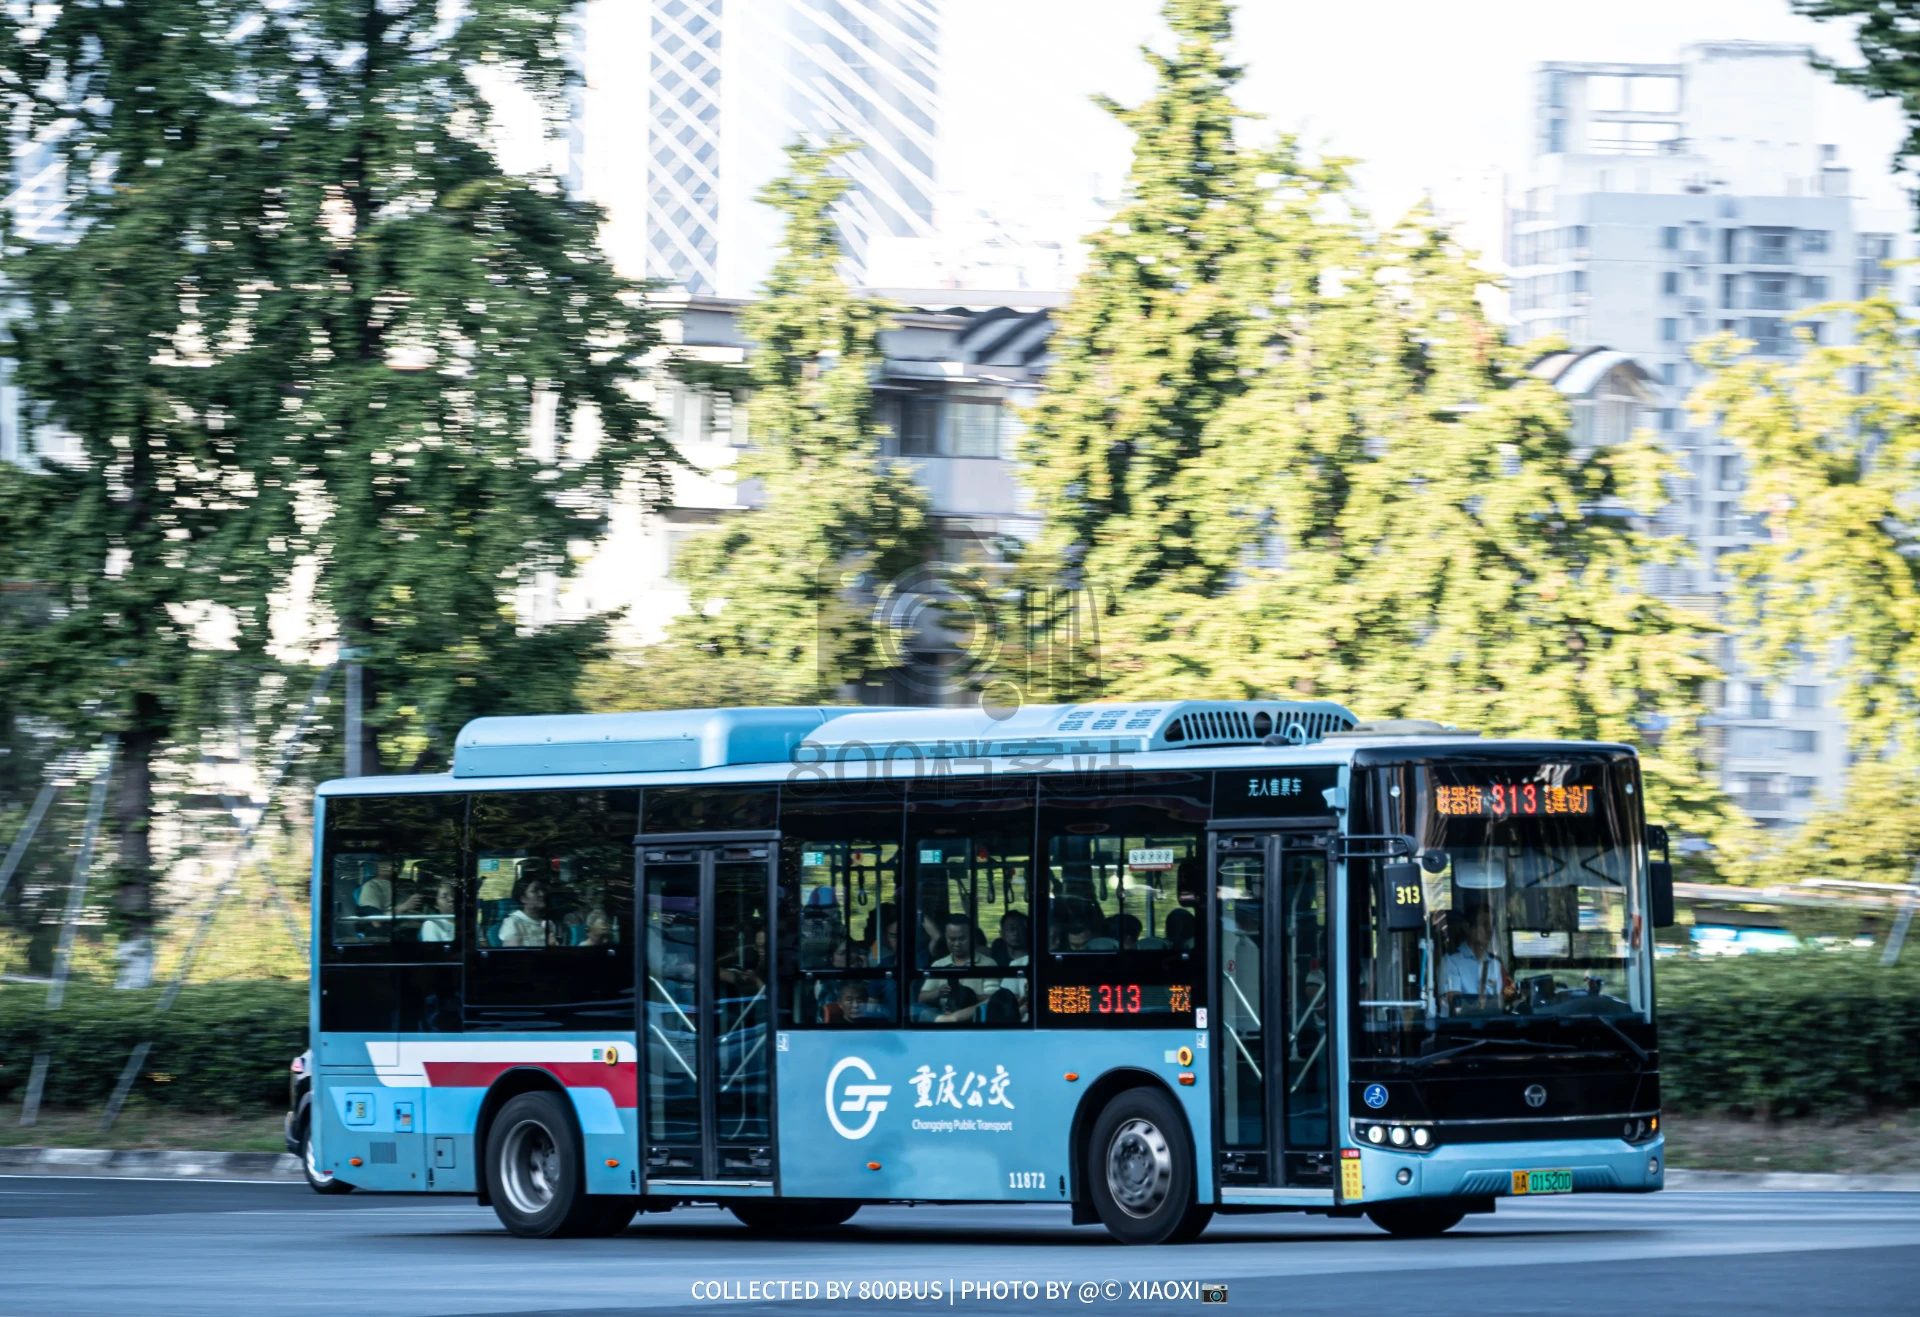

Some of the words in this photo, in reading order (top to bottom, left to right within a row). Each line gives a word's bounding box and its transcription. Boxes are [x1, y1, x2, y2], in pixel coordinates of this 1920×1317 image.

[1248, 777, 1302, 796] 无人售票车
[1492, 784, 1536, 814] 313
[1545, 784, 1593, 813] 建设厂
[1396, 886, 1420, 905] 313
[1098, 984, 1141, 1013] 313
[908, 1064, 1015, 1110] 重庆公交
[911, 1119, 953, 1132] Chongqing
[954, 1119, 976, 1131] Public
[976, 1119, 1013, 1133] Transport
[1009, 1172, 1046, 1189] 11872
